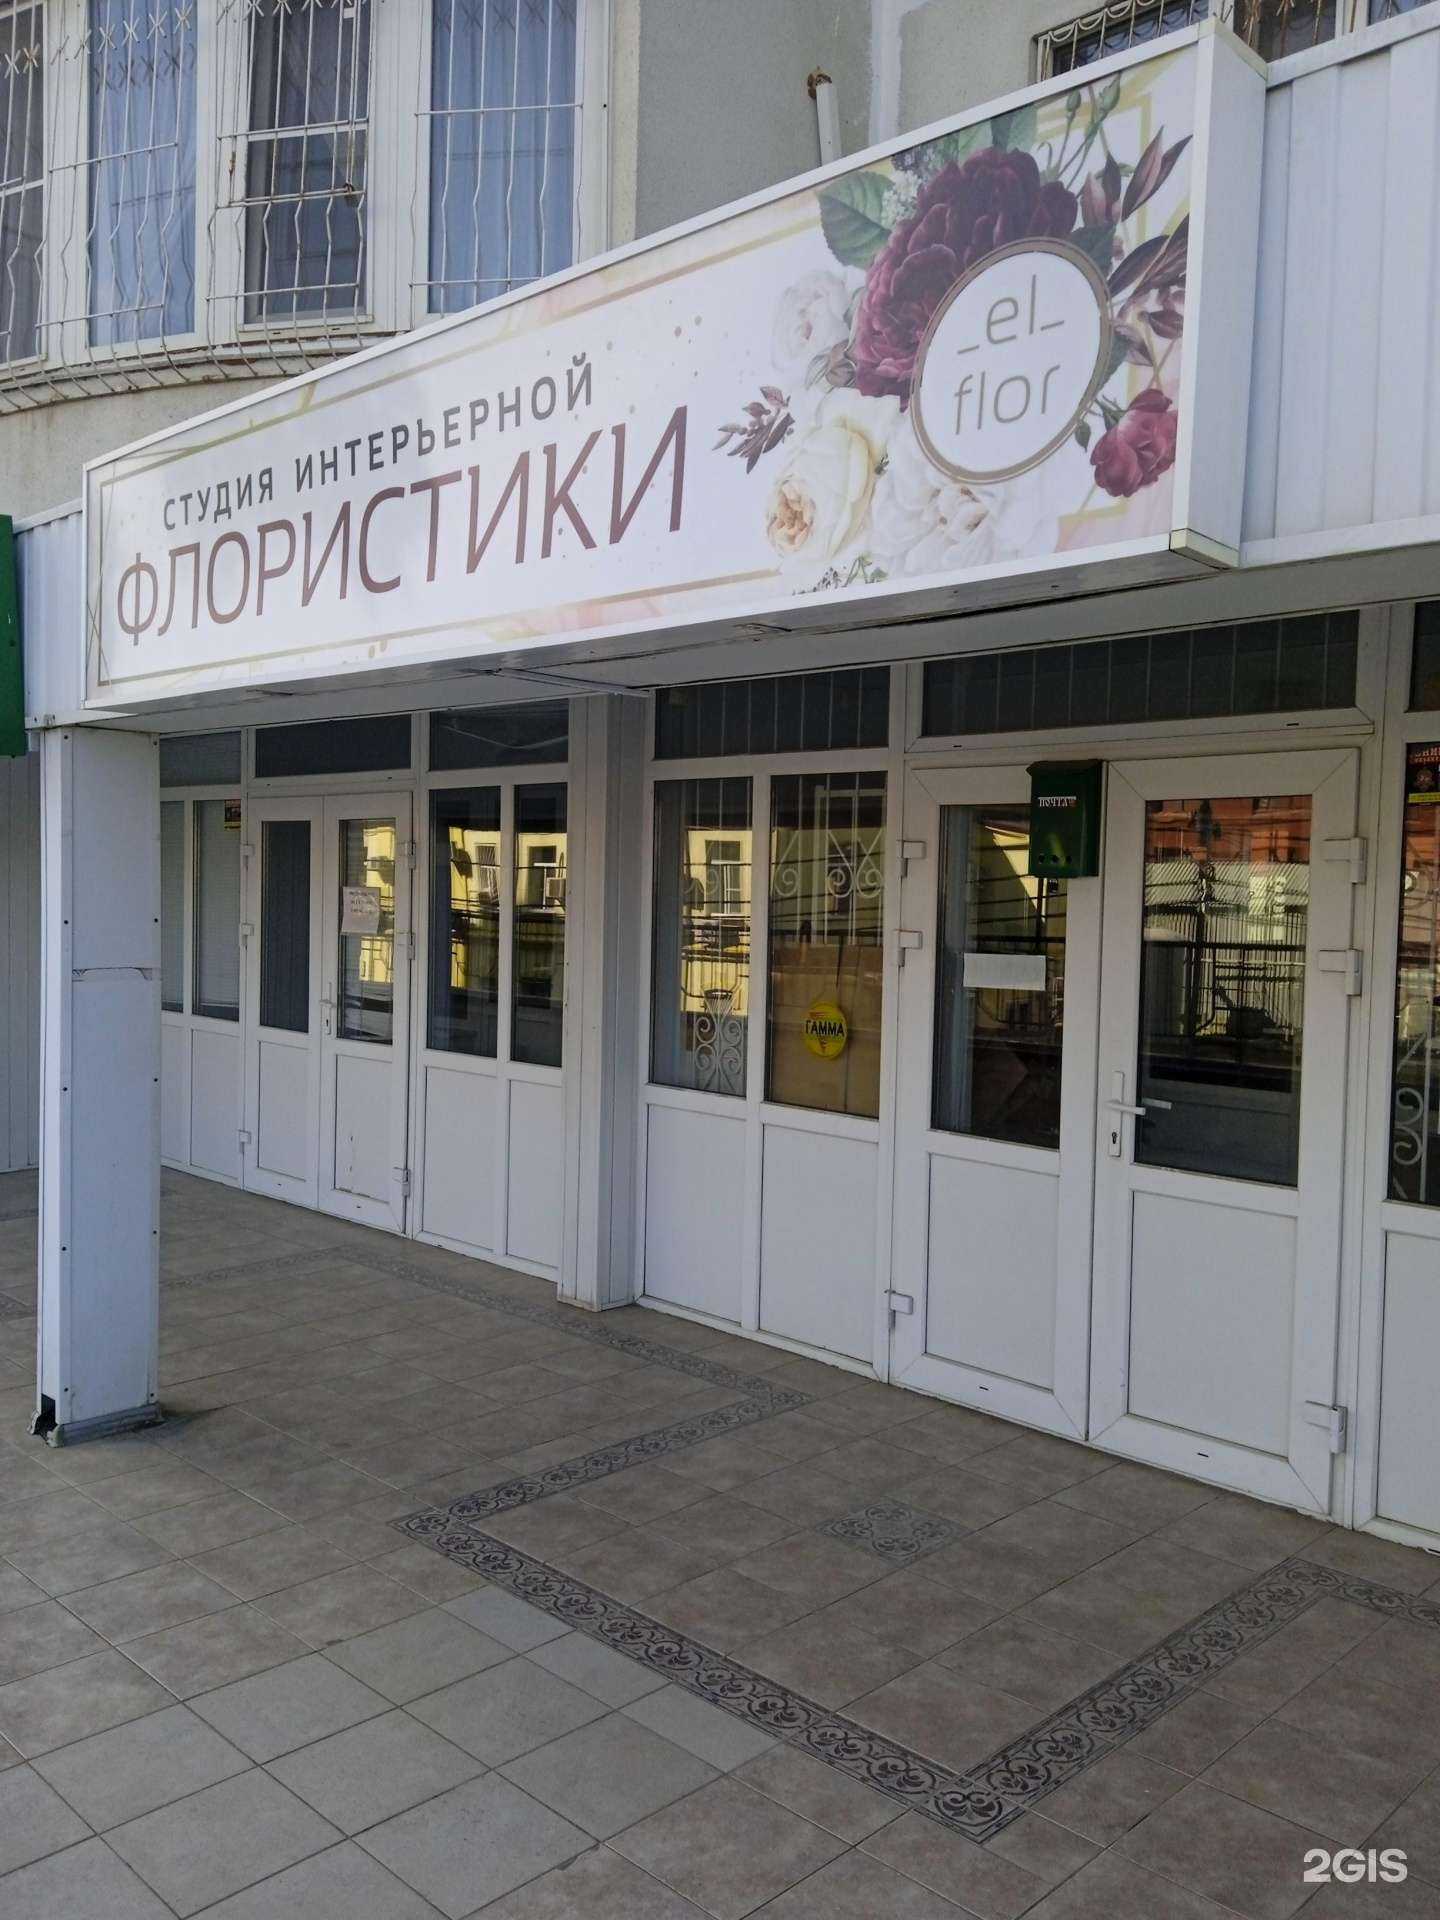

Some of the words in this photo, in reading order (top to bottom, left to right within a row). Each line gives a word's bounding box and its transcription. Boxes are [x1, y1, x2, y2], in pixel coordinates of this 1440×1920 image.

[163, 467, 273, 531] СТУДИЯ
[296, 352, 593, 493] ИНТЕРЬЕРНОЙ
[954, 364, 1061, 435] flor
[117, 405, 688, 646] ФЛОРИСТИКИ
[805, 1019, 845, 1037] ГАММА
